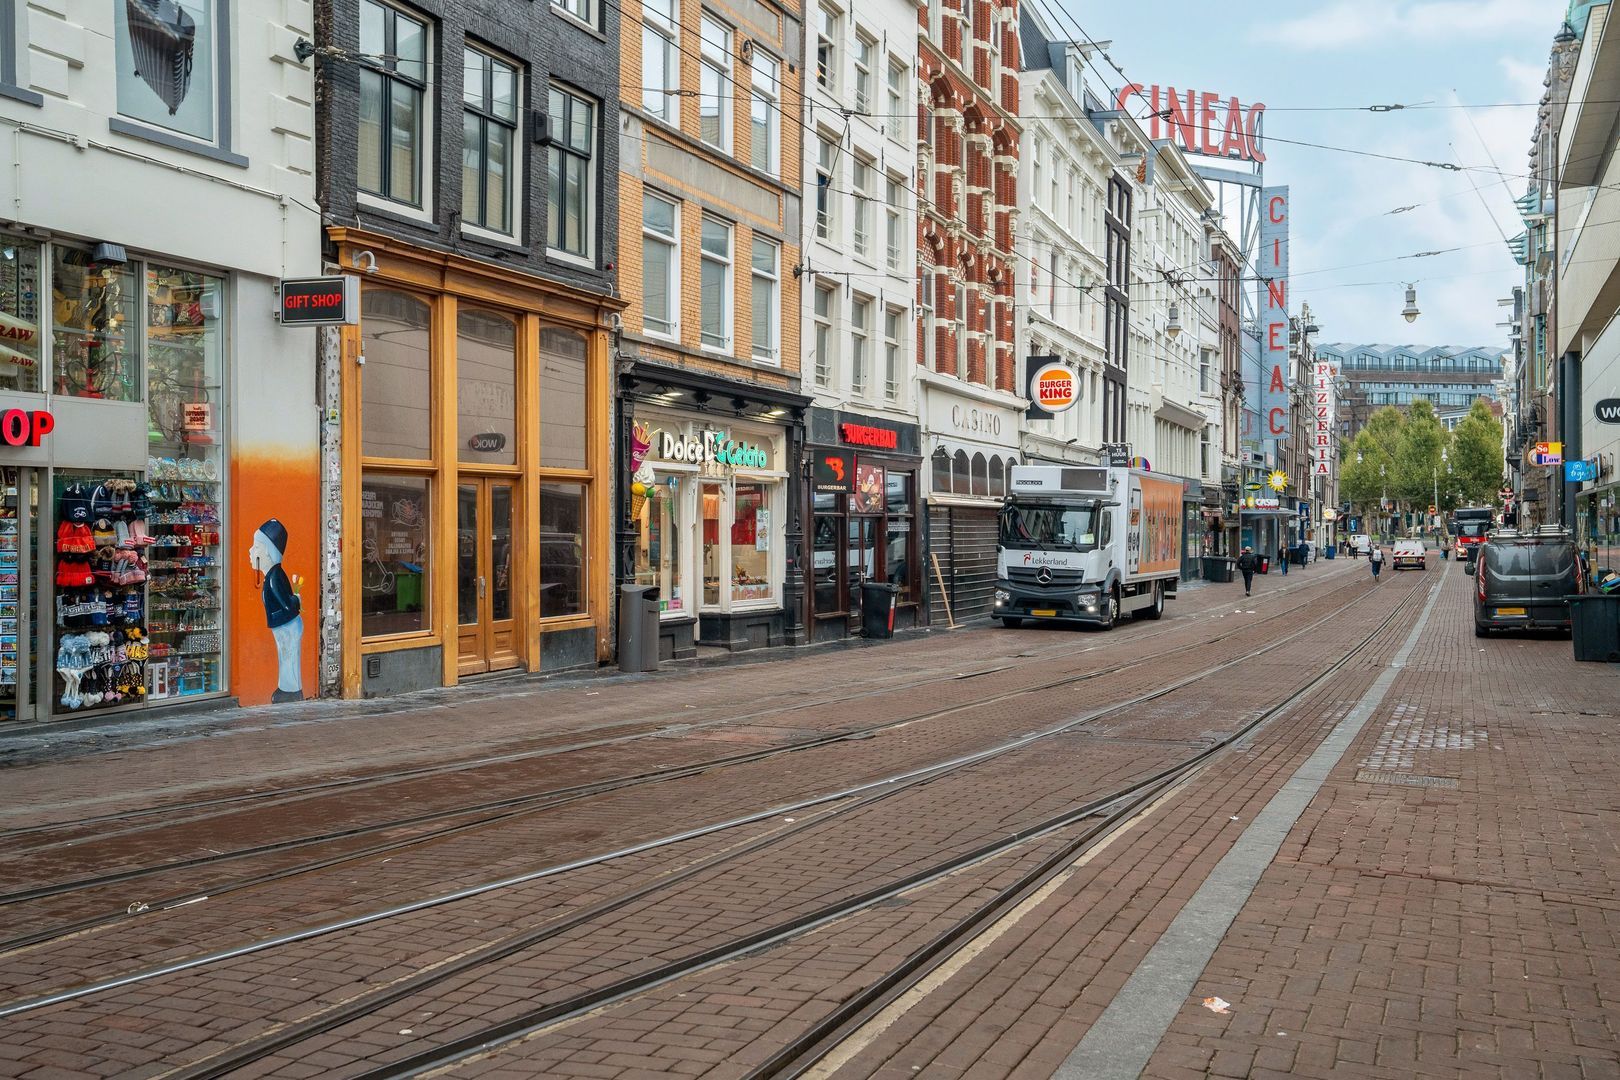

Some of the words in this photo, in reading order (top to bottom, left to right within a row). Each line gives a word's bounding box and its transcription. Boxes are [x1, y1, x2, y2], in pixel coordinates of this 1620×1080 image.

[1116, 83, 1266, 163] CINEAC
[285, 295, 310, 309] GIFT
[311, 293, 342, 308] SHOP
[1269, 196, 1285, 435] CINEAC
[9, 355, 34, 367] RAW
[1039, 380, 1072, 389] BURGER
[1039, 388, 1072, 399] KING
[952, 404, 1001, 436] CASINO
[1316, 364, 1329, 474] PIZZERIA
[842, 423, 897, 448] BURGERBAR
[726, 440, 767, 469] Gelato
[1536, 444, 1548, 453] So
[1543, 455, 1561, 464] Low
[1032, 557, 1068, 566] Lekkerland
